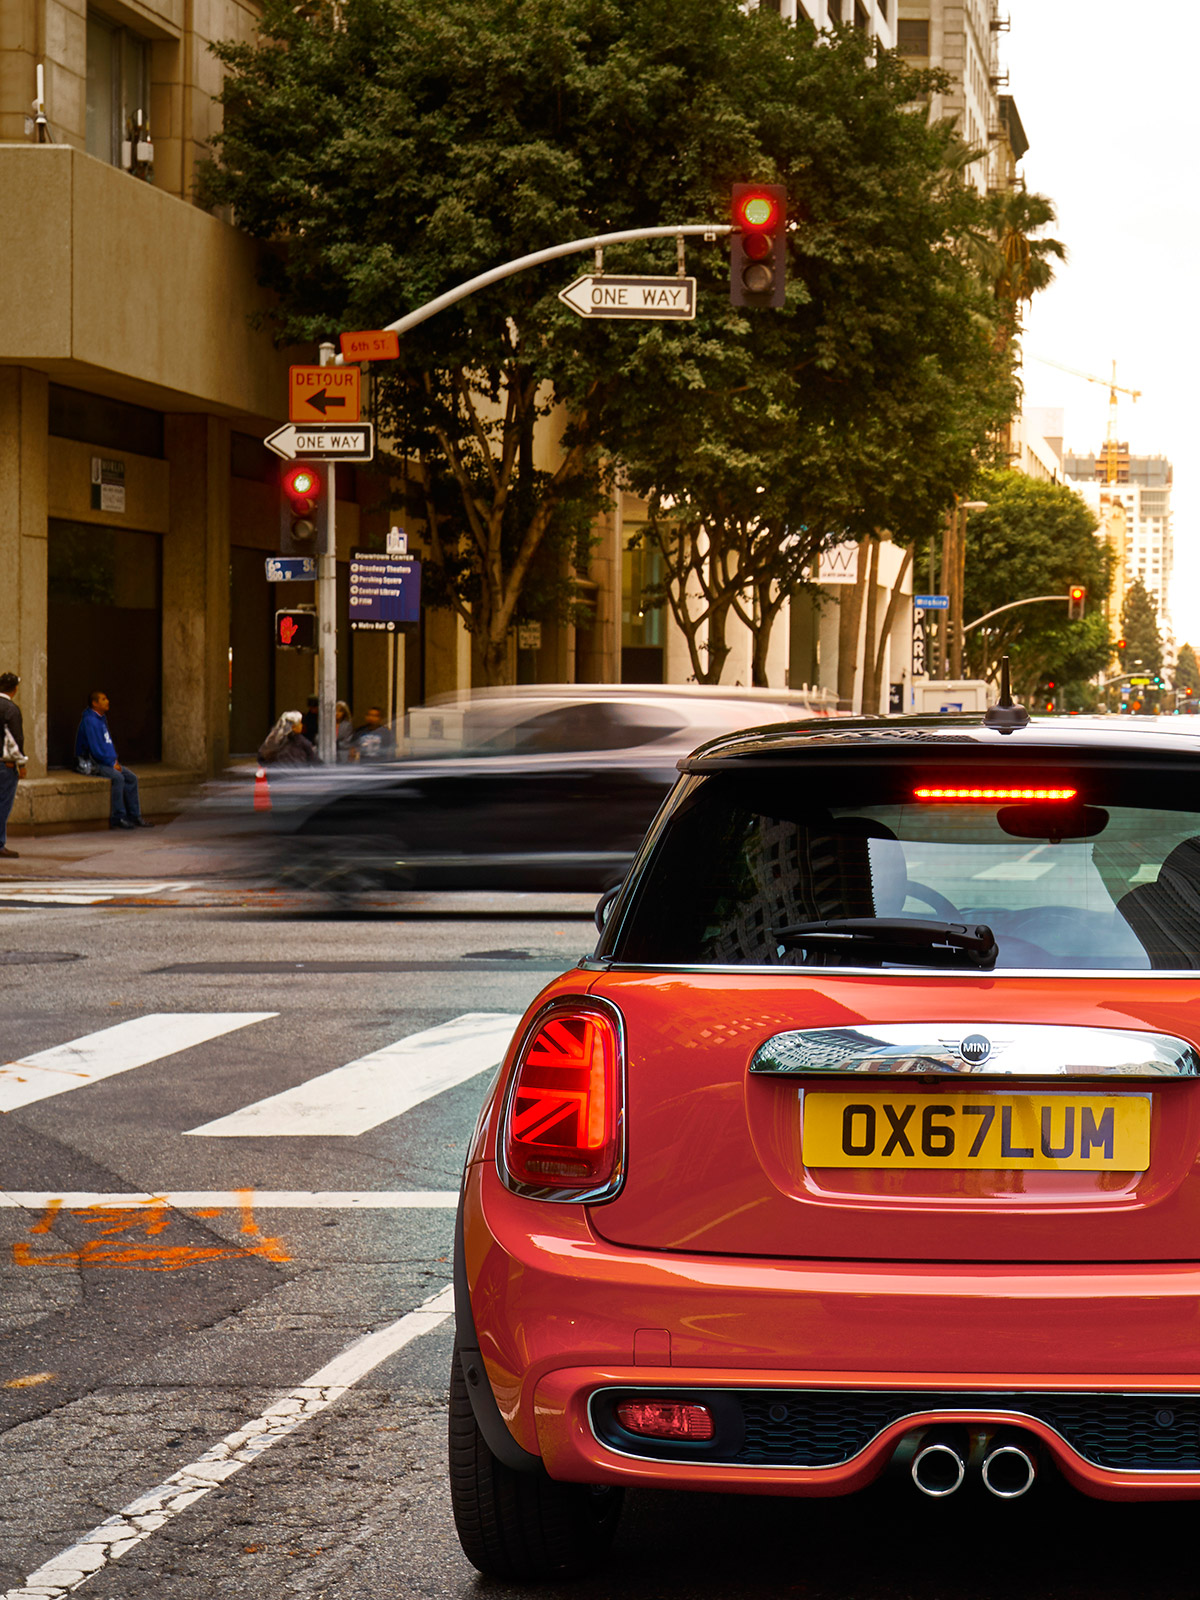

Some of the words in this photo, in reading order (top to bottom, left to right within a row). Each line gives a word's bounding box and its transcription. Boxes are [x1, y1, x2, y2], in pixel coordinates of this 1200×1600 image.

[591, 287, 628, 305] ONE
[642, 289, 681, 306] WAY
[351, 341, 369, 352] 6th
[296, 373, 353, 386] DETOUR
[296, 436, 325, 449] ONE
[330, 436, 360, 449] WAY
[914, 608, 924, 674] PARK
[963, 1043, 989, 1053] MINI
[842, 1104, 1114, 1159] OX67LUM
